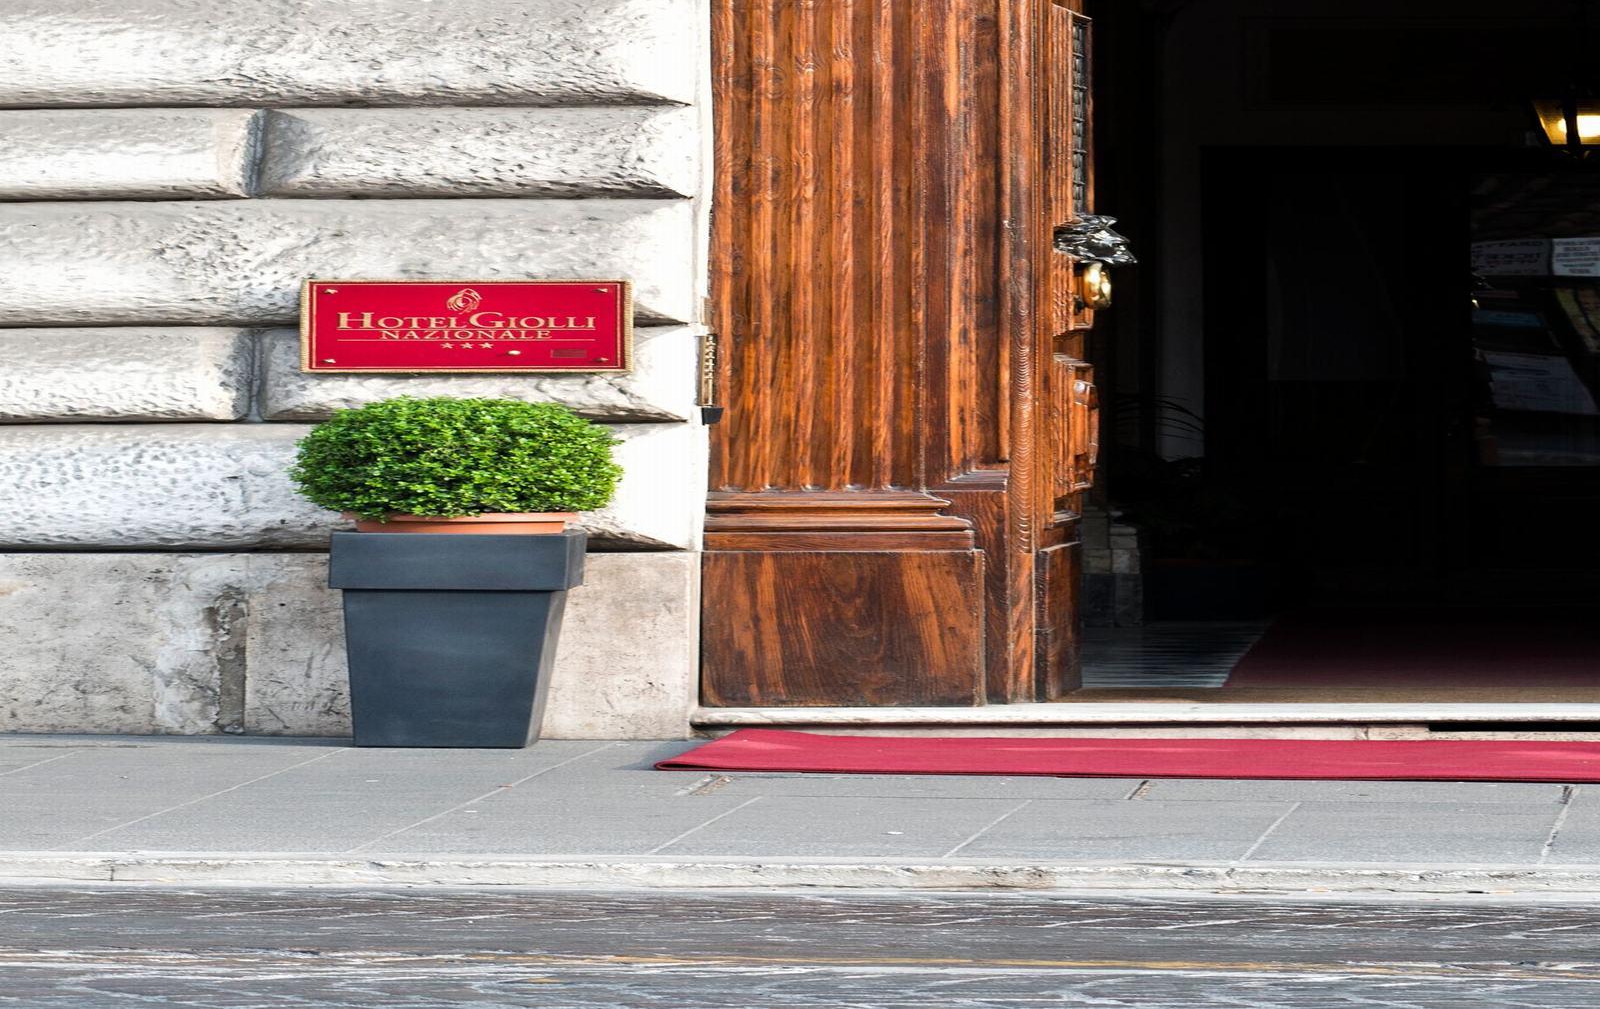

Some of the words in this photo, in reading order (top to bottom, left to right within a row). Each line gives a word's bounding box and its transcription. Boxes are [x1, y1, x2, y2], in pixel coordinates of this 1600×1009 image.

[337, 311, 466, 329] HOTEL
[468, 311, 596, 329] GIOLLI
[379, 329, 553, 340] NAZIONALE
